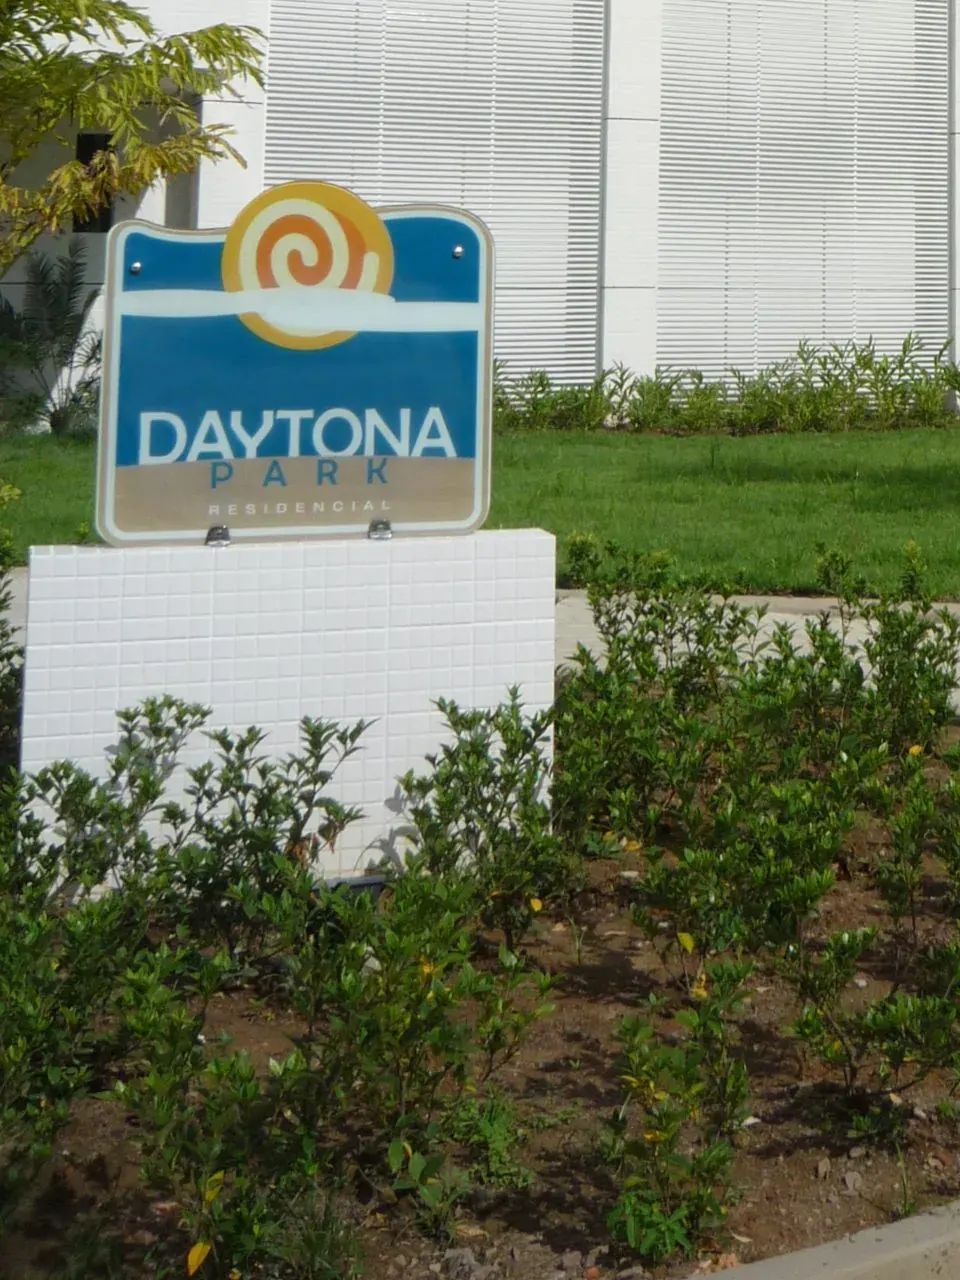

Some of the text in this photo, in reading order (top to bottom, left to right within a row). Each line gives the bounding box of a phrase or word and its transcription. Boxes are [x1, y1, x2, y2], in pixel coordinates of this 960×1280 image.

[137, 406, 458, 466] DAYTONA
[209, 458, 389, 490] PARK
[207, 500, 392, 517] RESIDENCIAL
